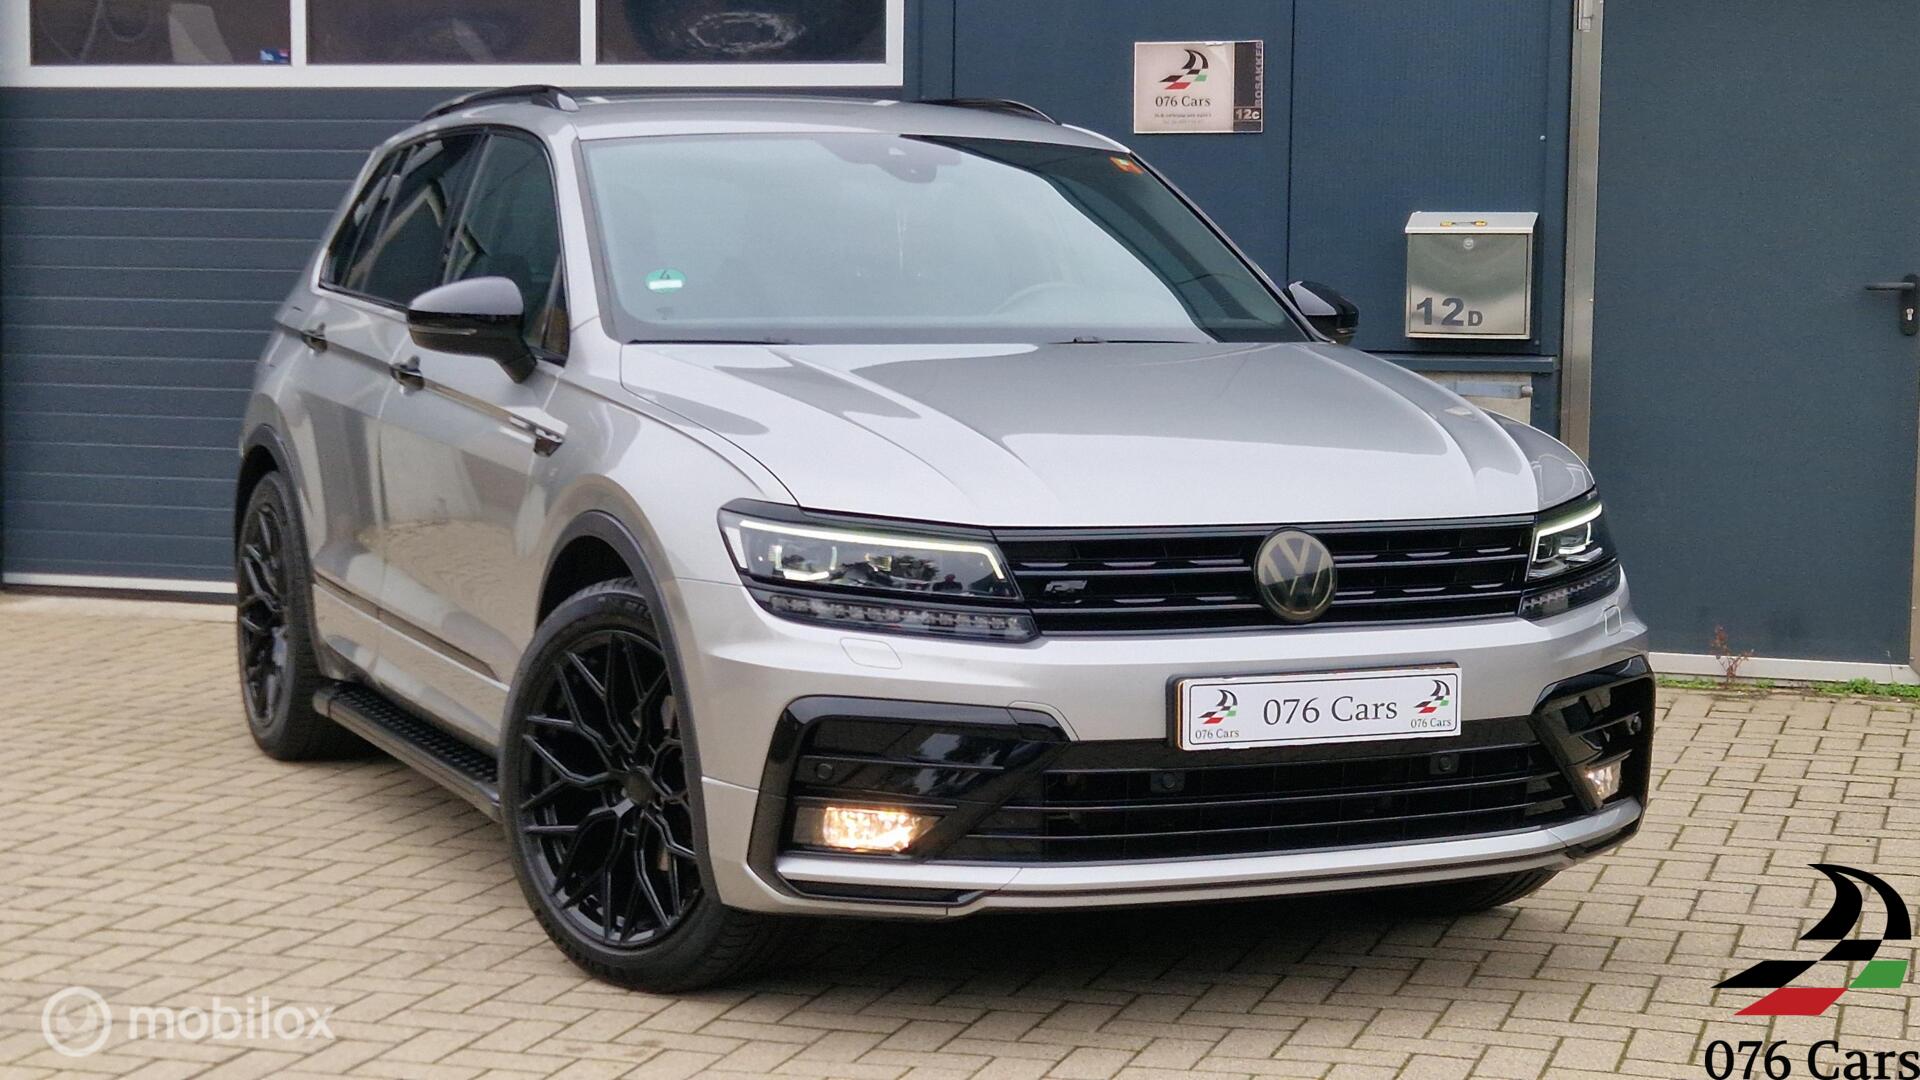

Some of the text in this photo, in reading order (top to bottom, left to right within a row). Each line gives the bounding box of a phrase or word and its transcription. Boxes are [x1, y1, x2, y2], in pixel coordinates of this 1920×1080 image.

[1155, 95, 1211, 107] 076 Cars
[1235, 108, 1260, 120] 12c
[1416, 297, 1483, 327] 12D
[1262, 695, 1398, 726] 076 Cars
[1410, 717, 1452, 729] 076 Cars
[1195, 728, 1240, 740] 076 Cars
